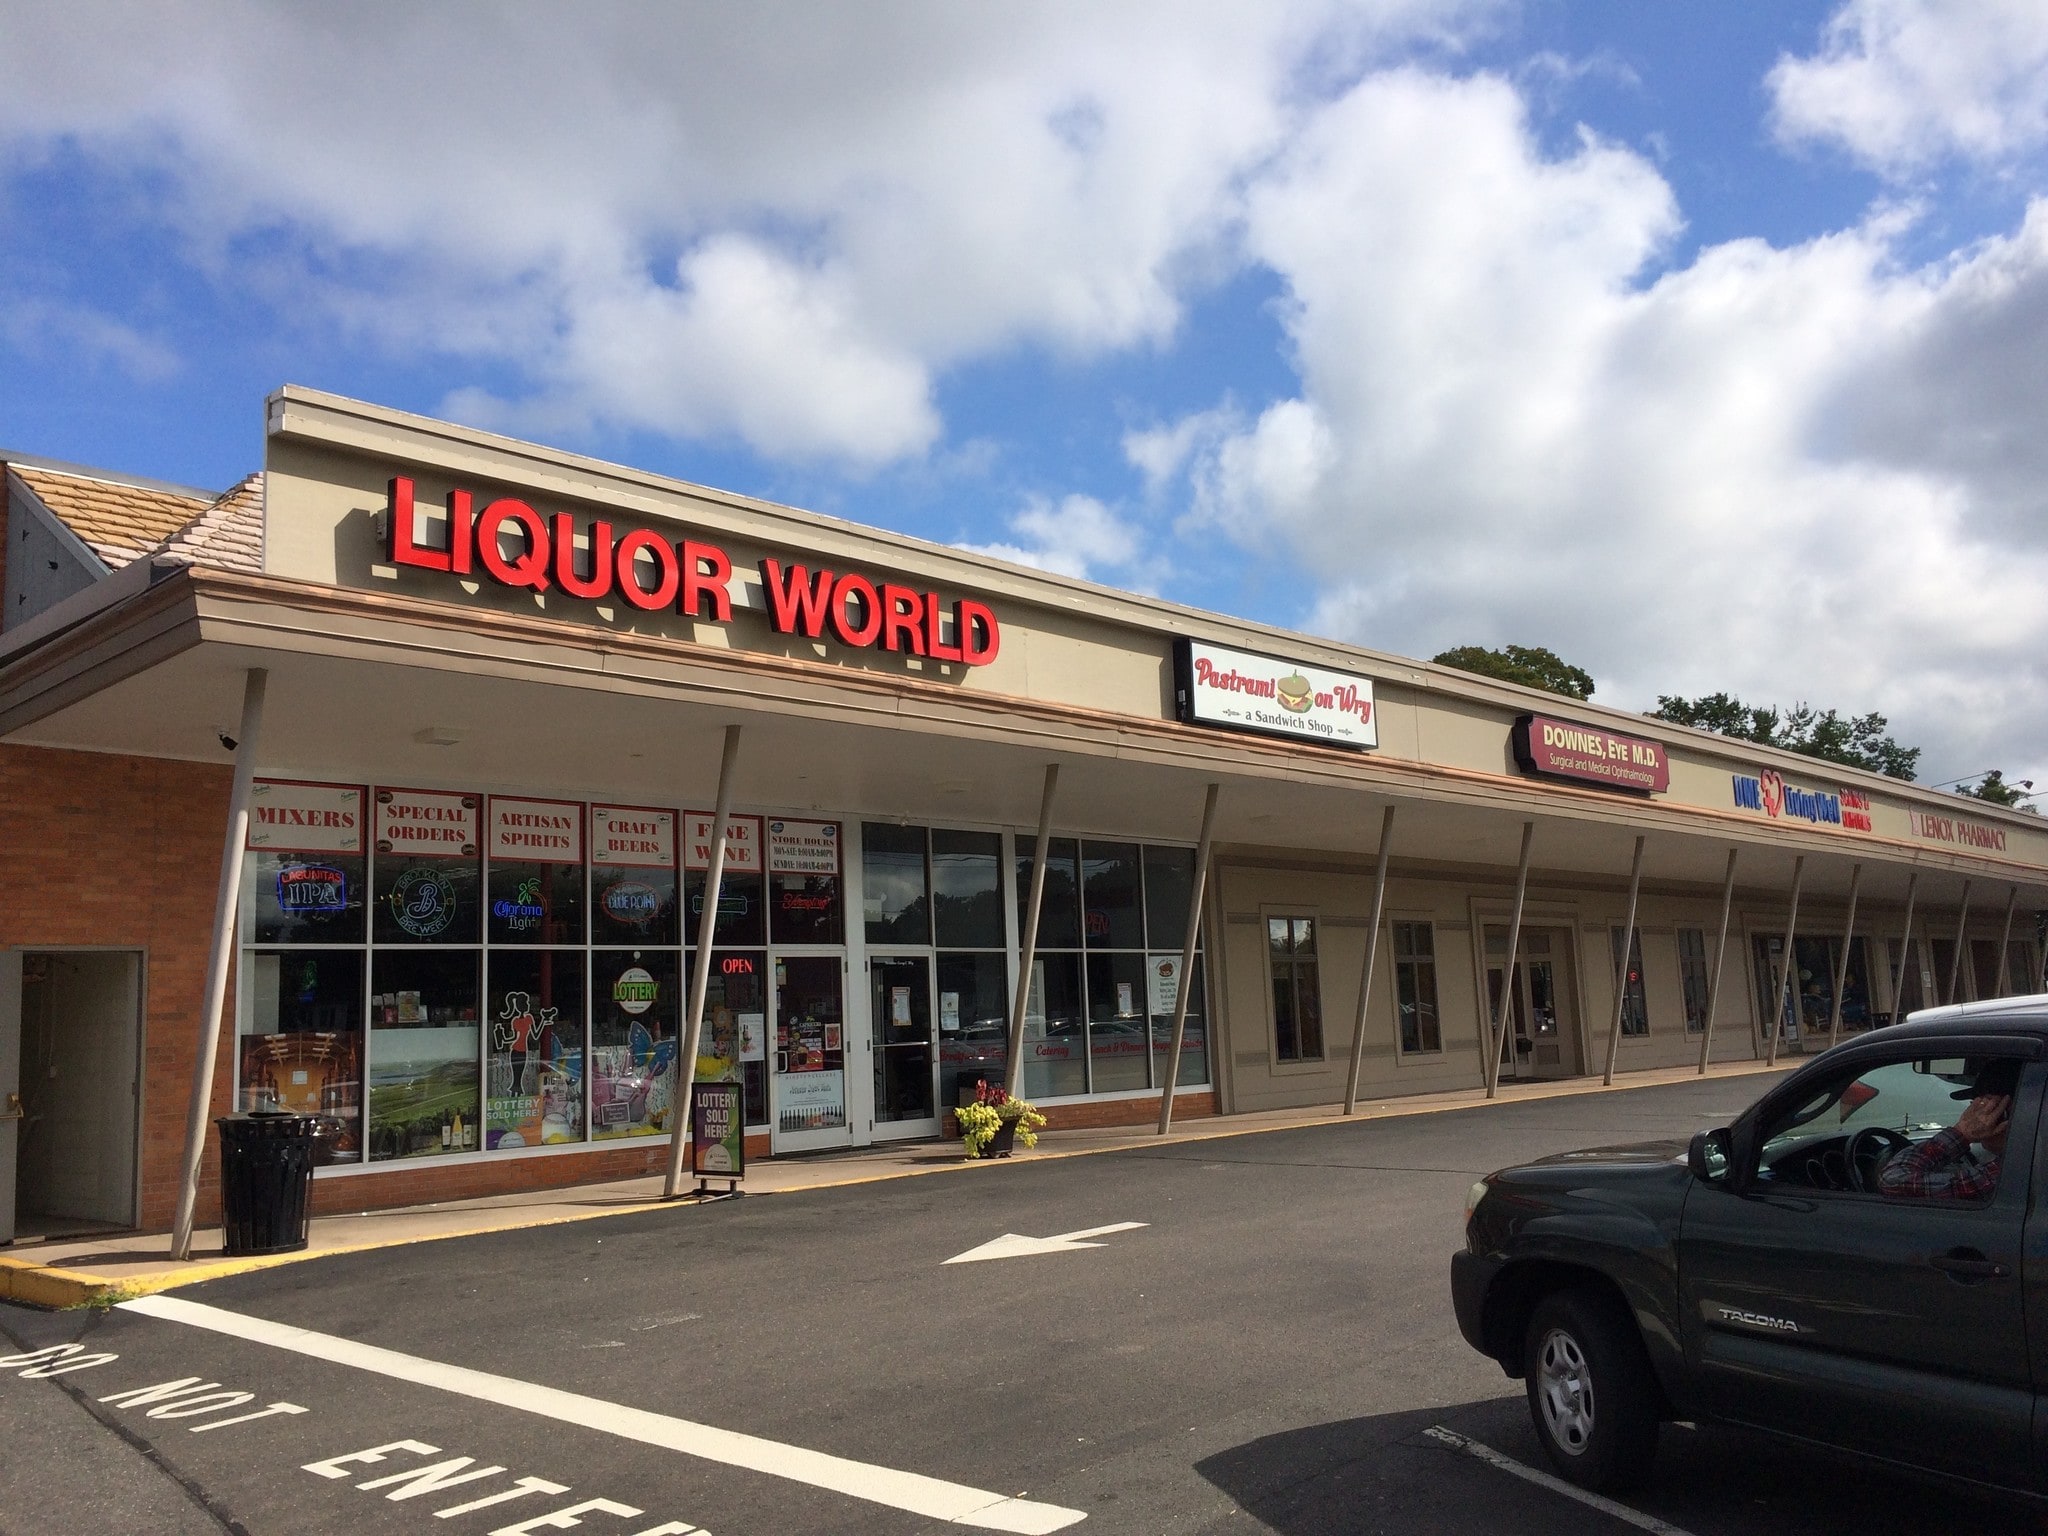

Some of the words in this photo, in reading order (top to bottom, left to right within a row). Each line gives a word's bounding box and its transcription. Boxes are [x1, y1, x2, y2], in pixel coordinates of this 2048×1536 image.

[387, 475, 733, 622] LIQUOR
[759, 557, 1000, 667] WORLD
[1195, 658, 1276, 699] Pastrami
[1315, 691, 1334, 710] on
[1333, 684, 1372, 725] Wry
[1245, 710, 1252, 721] a
[1255, 710, 1305, 730] Sandwich
[1307, 719, 1334, 737] Shop
[1543, 724, 1607, 760] DOWNES,
[1608, 739, 1629, 761] EYE
[1632, 744, 1660, 769] M.D.
[1549, 752, 1574, 770] Surgical
[1575, 759, 1588, 771] and
[1588, 760, 1611, 776] Medical
[1611, 765, 1655, 787] Ophthalmology
[1732, 775, 1762, 811] DME
[255, 806, 355, 829] MIXERS
[387, 804, 467, 822] SPECIAL
[498, 812, 572, 830] ARTISAN
[387, 825, 466, 843] ORDERS
[608, 820, 660, 835] CRAFT
[697, 822, 749, 840] FNE
[1920, 813, 1955, 843] LENOX
[1956, 821, 2007, 852] PHARMACY
[500, 832, 571, 849] SPIRITS
[608, 839, 660, 853] BEERS
[772, 835, 801, 845] STORE
[804, 836, 835, 846] HOURS
[695, 845, 751, 862] WNE
[281, 869, 342, 883] LAGUNITAS
[288, 883, 340, 904] IPA
[608, 893, 630, 910] BLUE
[493, 900, 543, 918] Corona
[398, 914, 448, 934] BREWERY
[508, 915, 536, 931] Light
[722, 958, 753, 974] OPEN
[613, 982, 660, 1001] LOTTERY
[1035, 1044, 1070, 1059] Catering
[487, 1098, 540, 1111] LOTTERY
[697, 1093, 738, 1108] LOTTERY
[486, 1110, 511, 1120] SOLD
[512, 1109, 540, 1118] HERE!
[705, 1109, 729, 1124] SOLD
[703, 1124, 732, 1139] HERE!
[1718, 1308, 1799, 1332] TACOMA
[0, 1343, 119, 1378] DO
[97, 1376, 310, 1433] NOT
